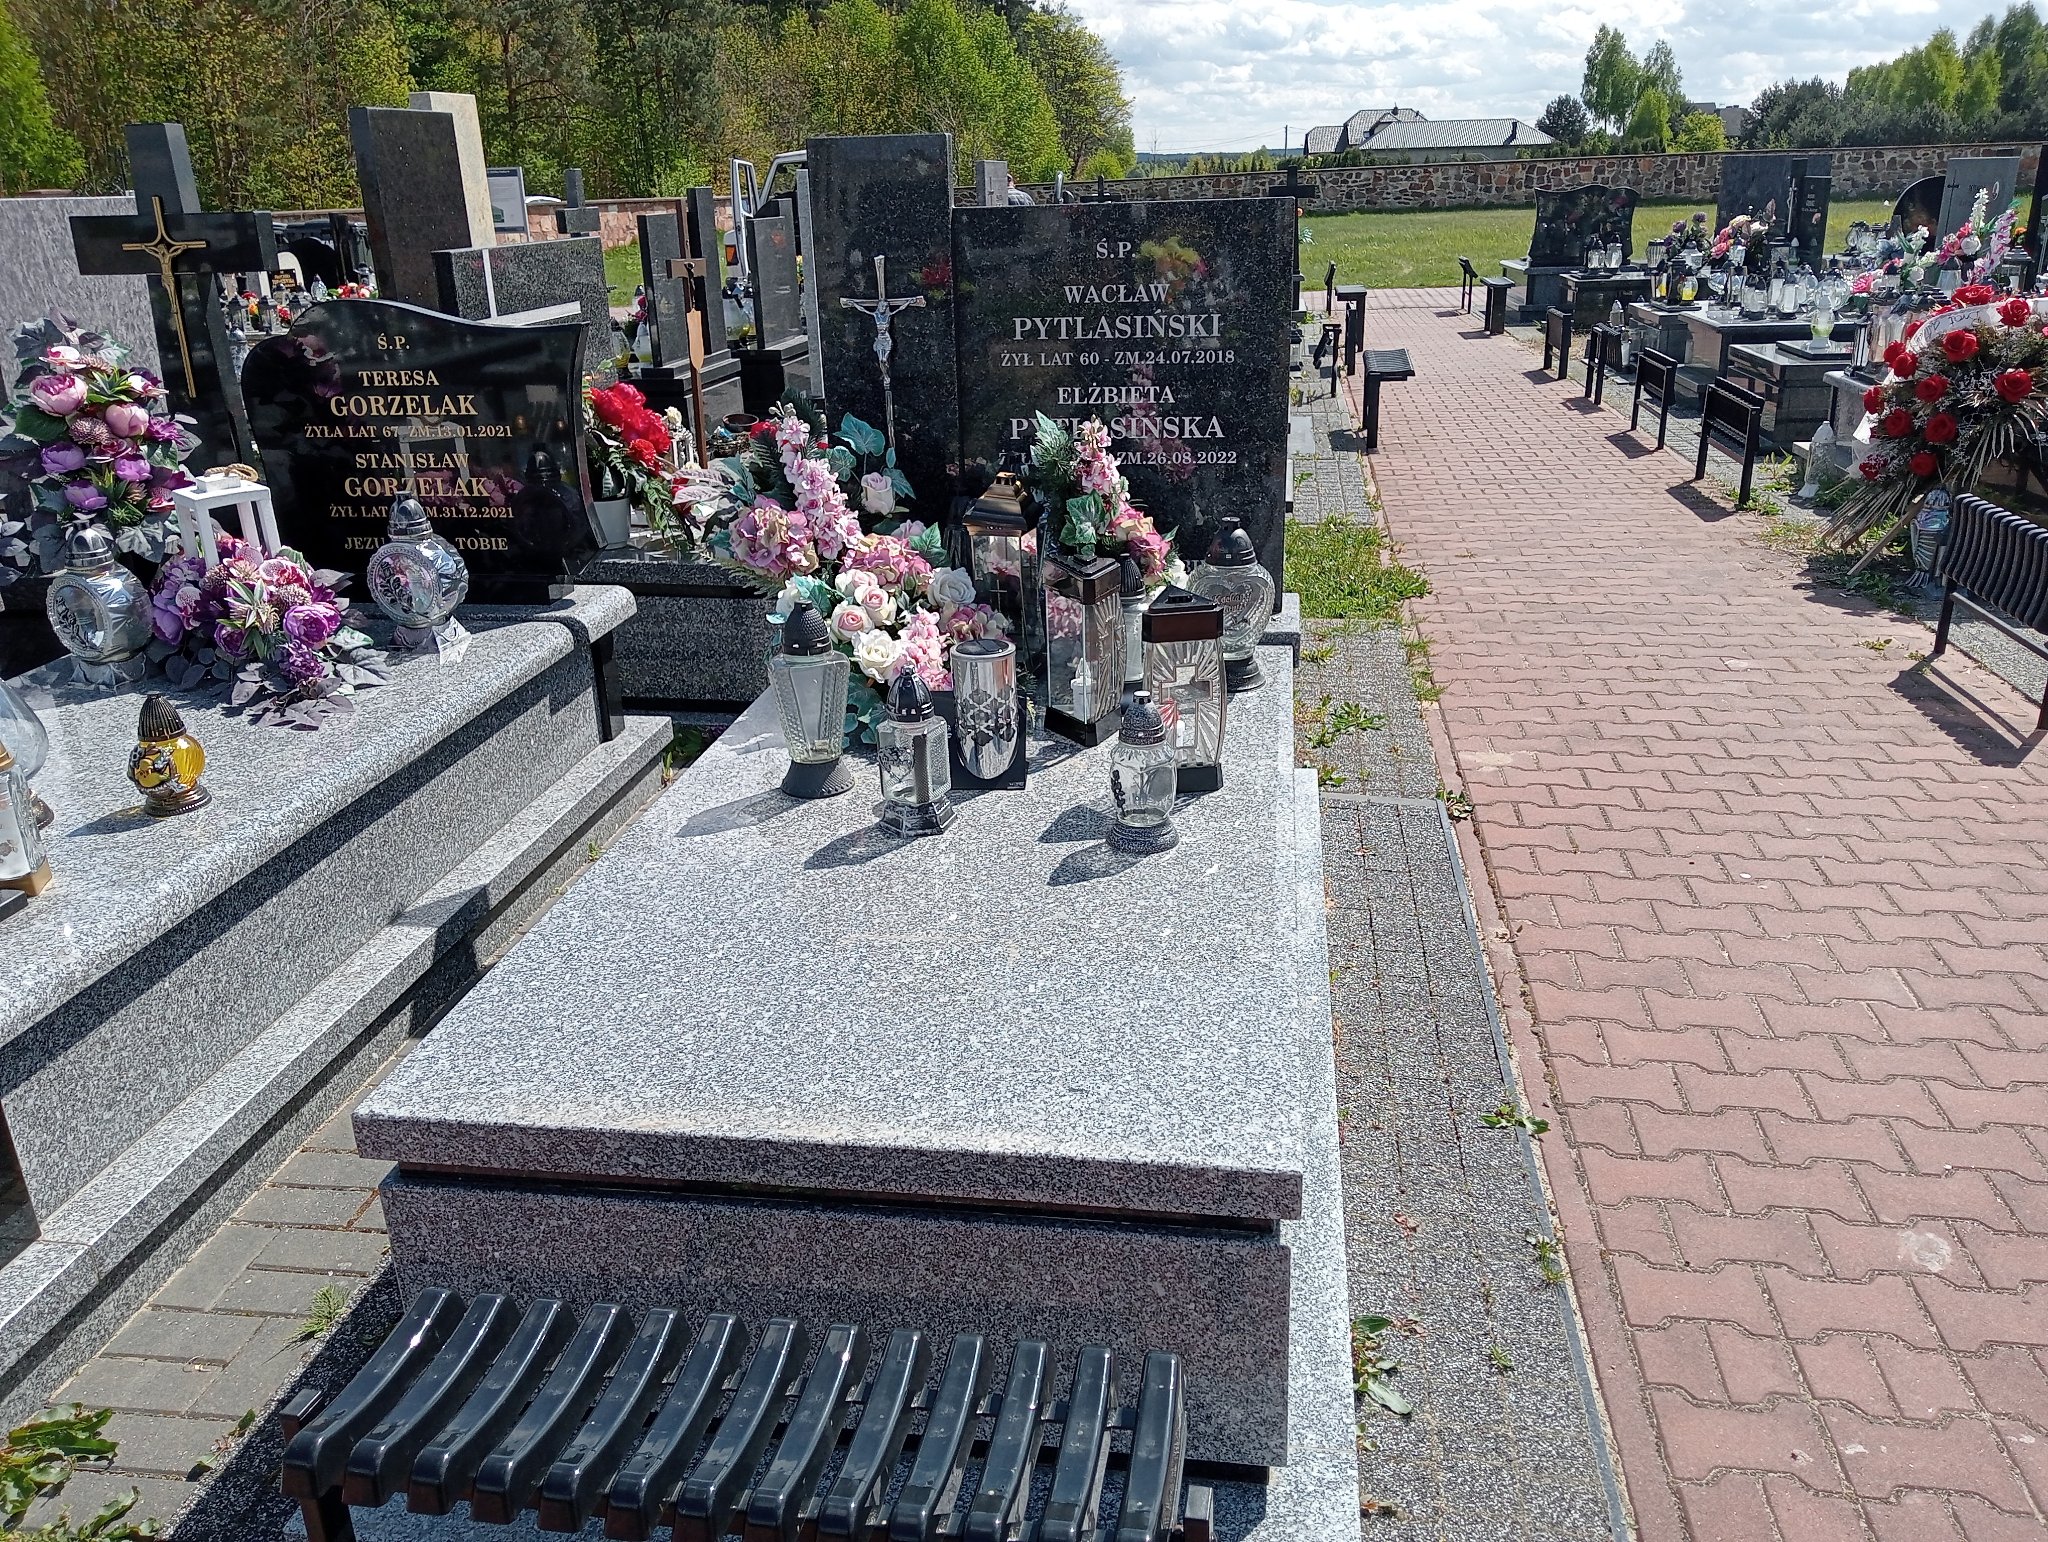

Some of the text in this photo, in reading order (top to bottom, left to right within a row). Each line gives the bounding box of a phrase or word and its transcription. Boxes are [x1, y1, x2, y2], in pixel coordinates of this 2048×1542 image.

[1096, 237, 1136, 260] Ś.P.
[1063, 283, 1170, 304] WACŁAW
[1012, 309, 1221, 341] PYTLASIŃSKI
[377, 332, 410, 350] Ś.P.
[1001, 350, 1034, 367] ŻYŁ
[1040, 352, 1074, 366] LAT
[1079, 352, 1100, 366] 60
[1114, 350, 1235, 366] ZM.24.07.2018
[358, 370, 440, 387] TERESA
[1056, 382, 1175, 405] ELŻBIETA
[330, 394, 478, 417] GORZELAK
[304, 423, 513, 438] ŻYŁA LAT 67 ZM.13.01.2021
[355, 453, 470, 469] STANISŁAW
[1117, 451, 1238, 466] ZM.26.08.2022
[344, 476, 490, 498] GORZELAK
[329, 503, 515, 519] ŻYŁ LAT M.31.12.2021
[455, 537, 508, 551] TOBIE
